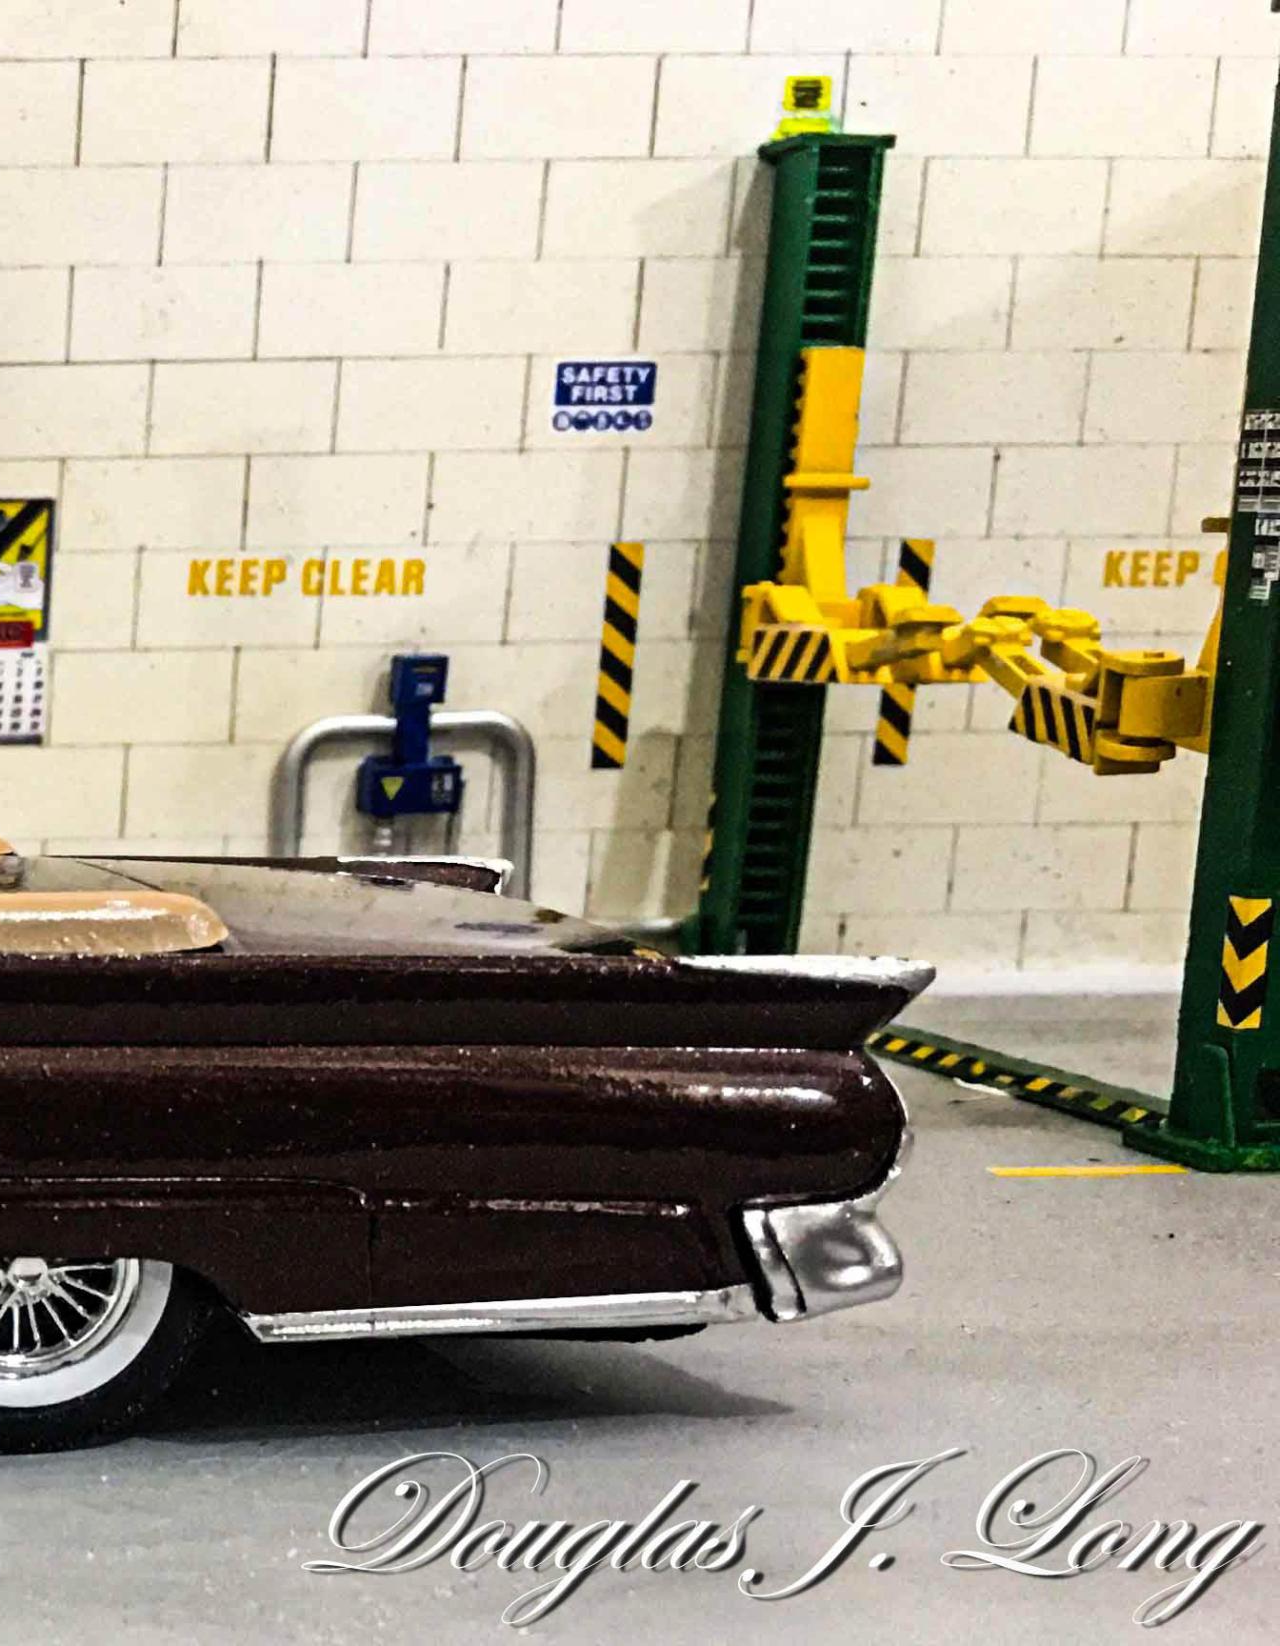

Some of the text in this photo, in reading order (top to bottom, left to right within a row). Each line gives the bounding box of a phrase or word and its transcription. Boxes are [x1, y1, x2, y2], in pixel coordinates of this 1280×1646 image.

[561, 366, 650, 383] SAFETY
[571, 385, 638, 402] FIRST
[187, 558, 427, 597] KEEP CLEAR
[1102, 550, 1200, 588] KEEP
